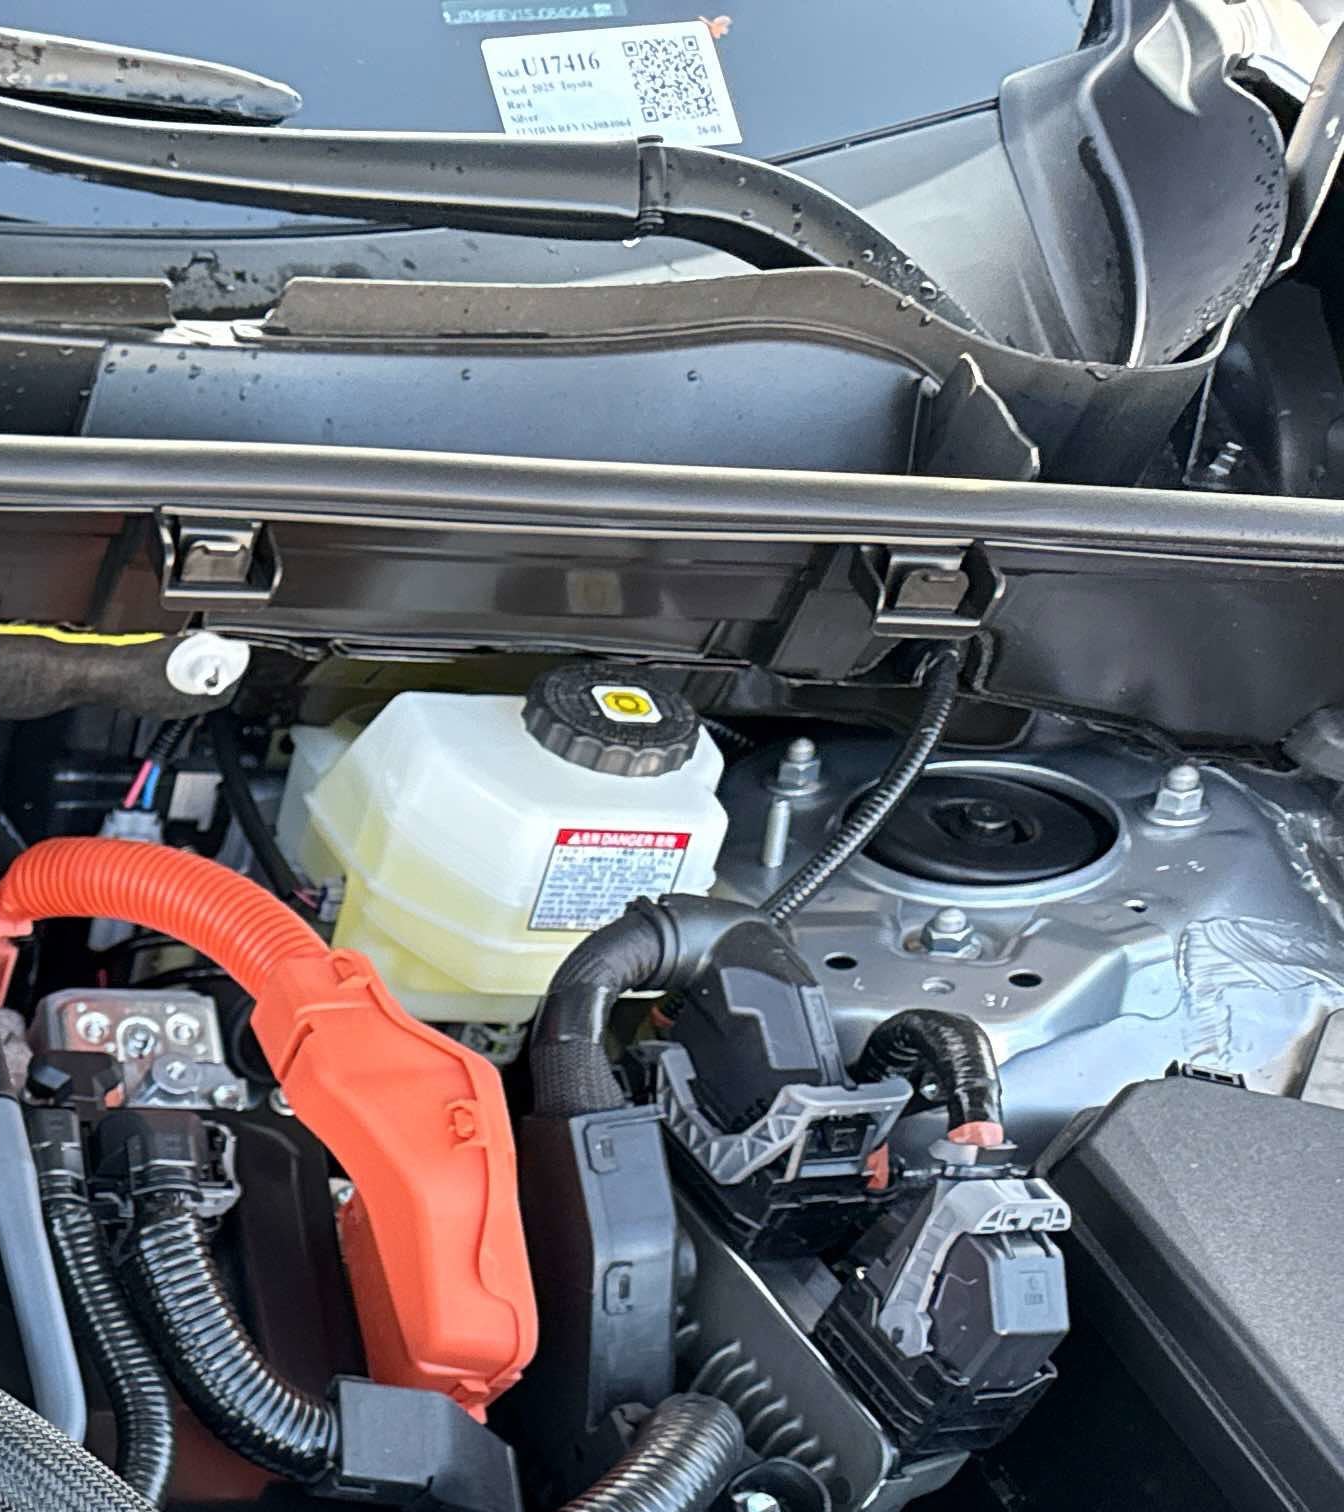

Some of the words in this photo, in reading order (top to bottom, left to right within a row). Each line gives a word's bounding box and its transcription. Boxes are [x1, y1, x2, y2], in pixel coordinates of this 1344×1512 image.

[521, 52, 600, 77] U17416
[561, 79, 593, 92] Toyota
[601, 832, 655, 847] DANGER
